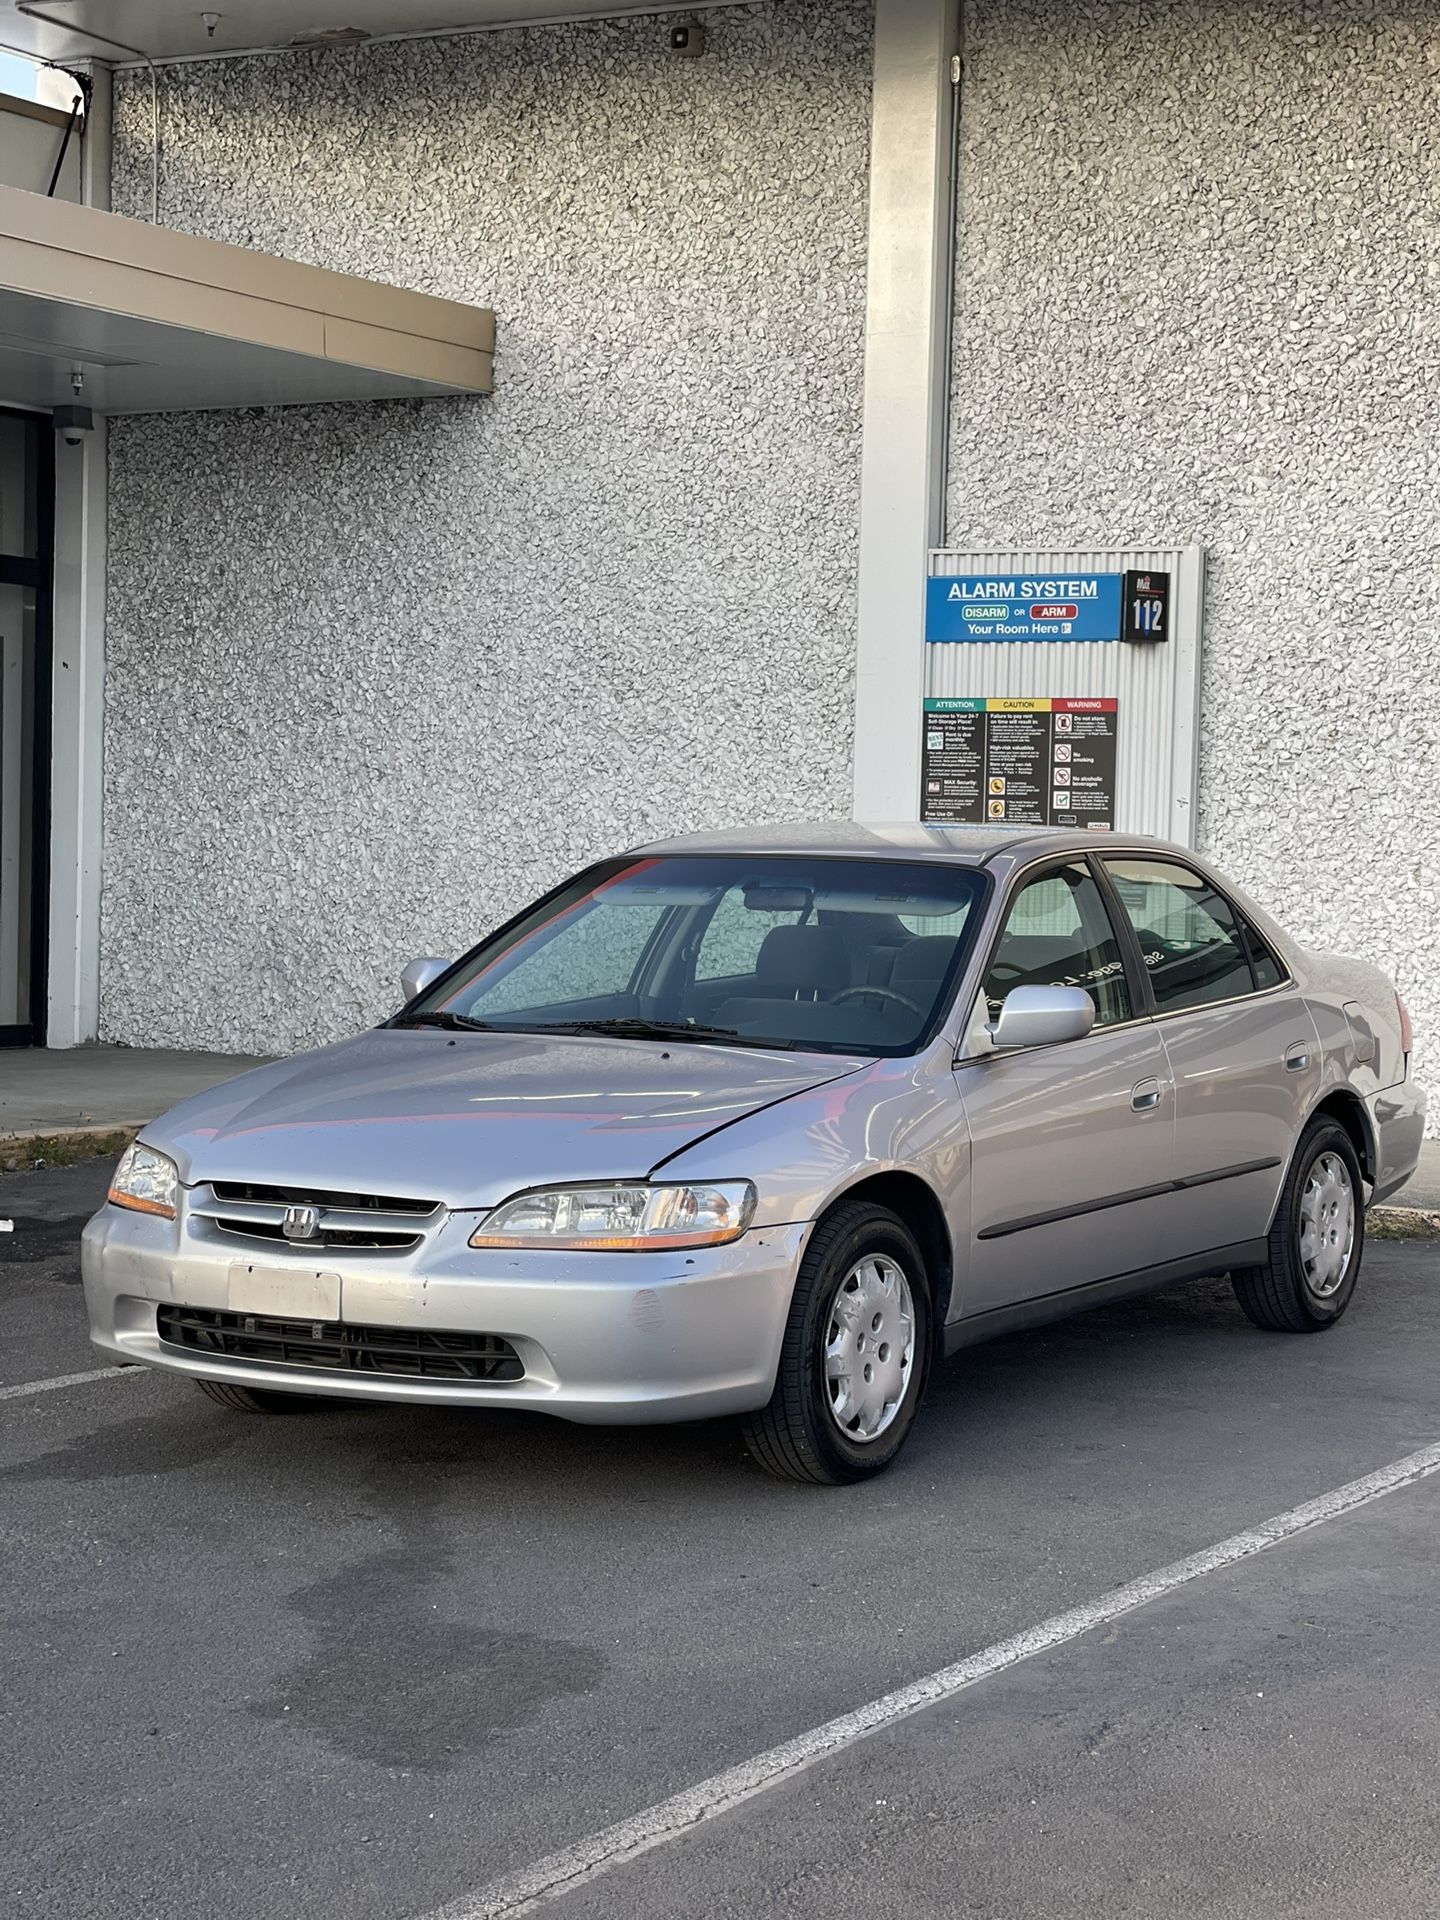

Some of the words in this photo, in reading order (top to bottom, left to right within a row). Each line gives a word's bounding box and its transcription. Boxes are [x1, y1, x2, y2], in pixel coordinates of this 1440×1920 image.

[948, 581, 1015, 598] ALARM
[1020, 580, 1097, 598] SYSTEM
[965, 608, 1006, 618] DISARM
[1014, 608, 1026, 616] OR
[1041, 606, 1066, 617] ARM
[1133, 599, 1162, 631] 112
[968, 624, 993, 634] Your
[996, 623, 1029, 634] Room
[1032, 622, 1058, 634] Here
